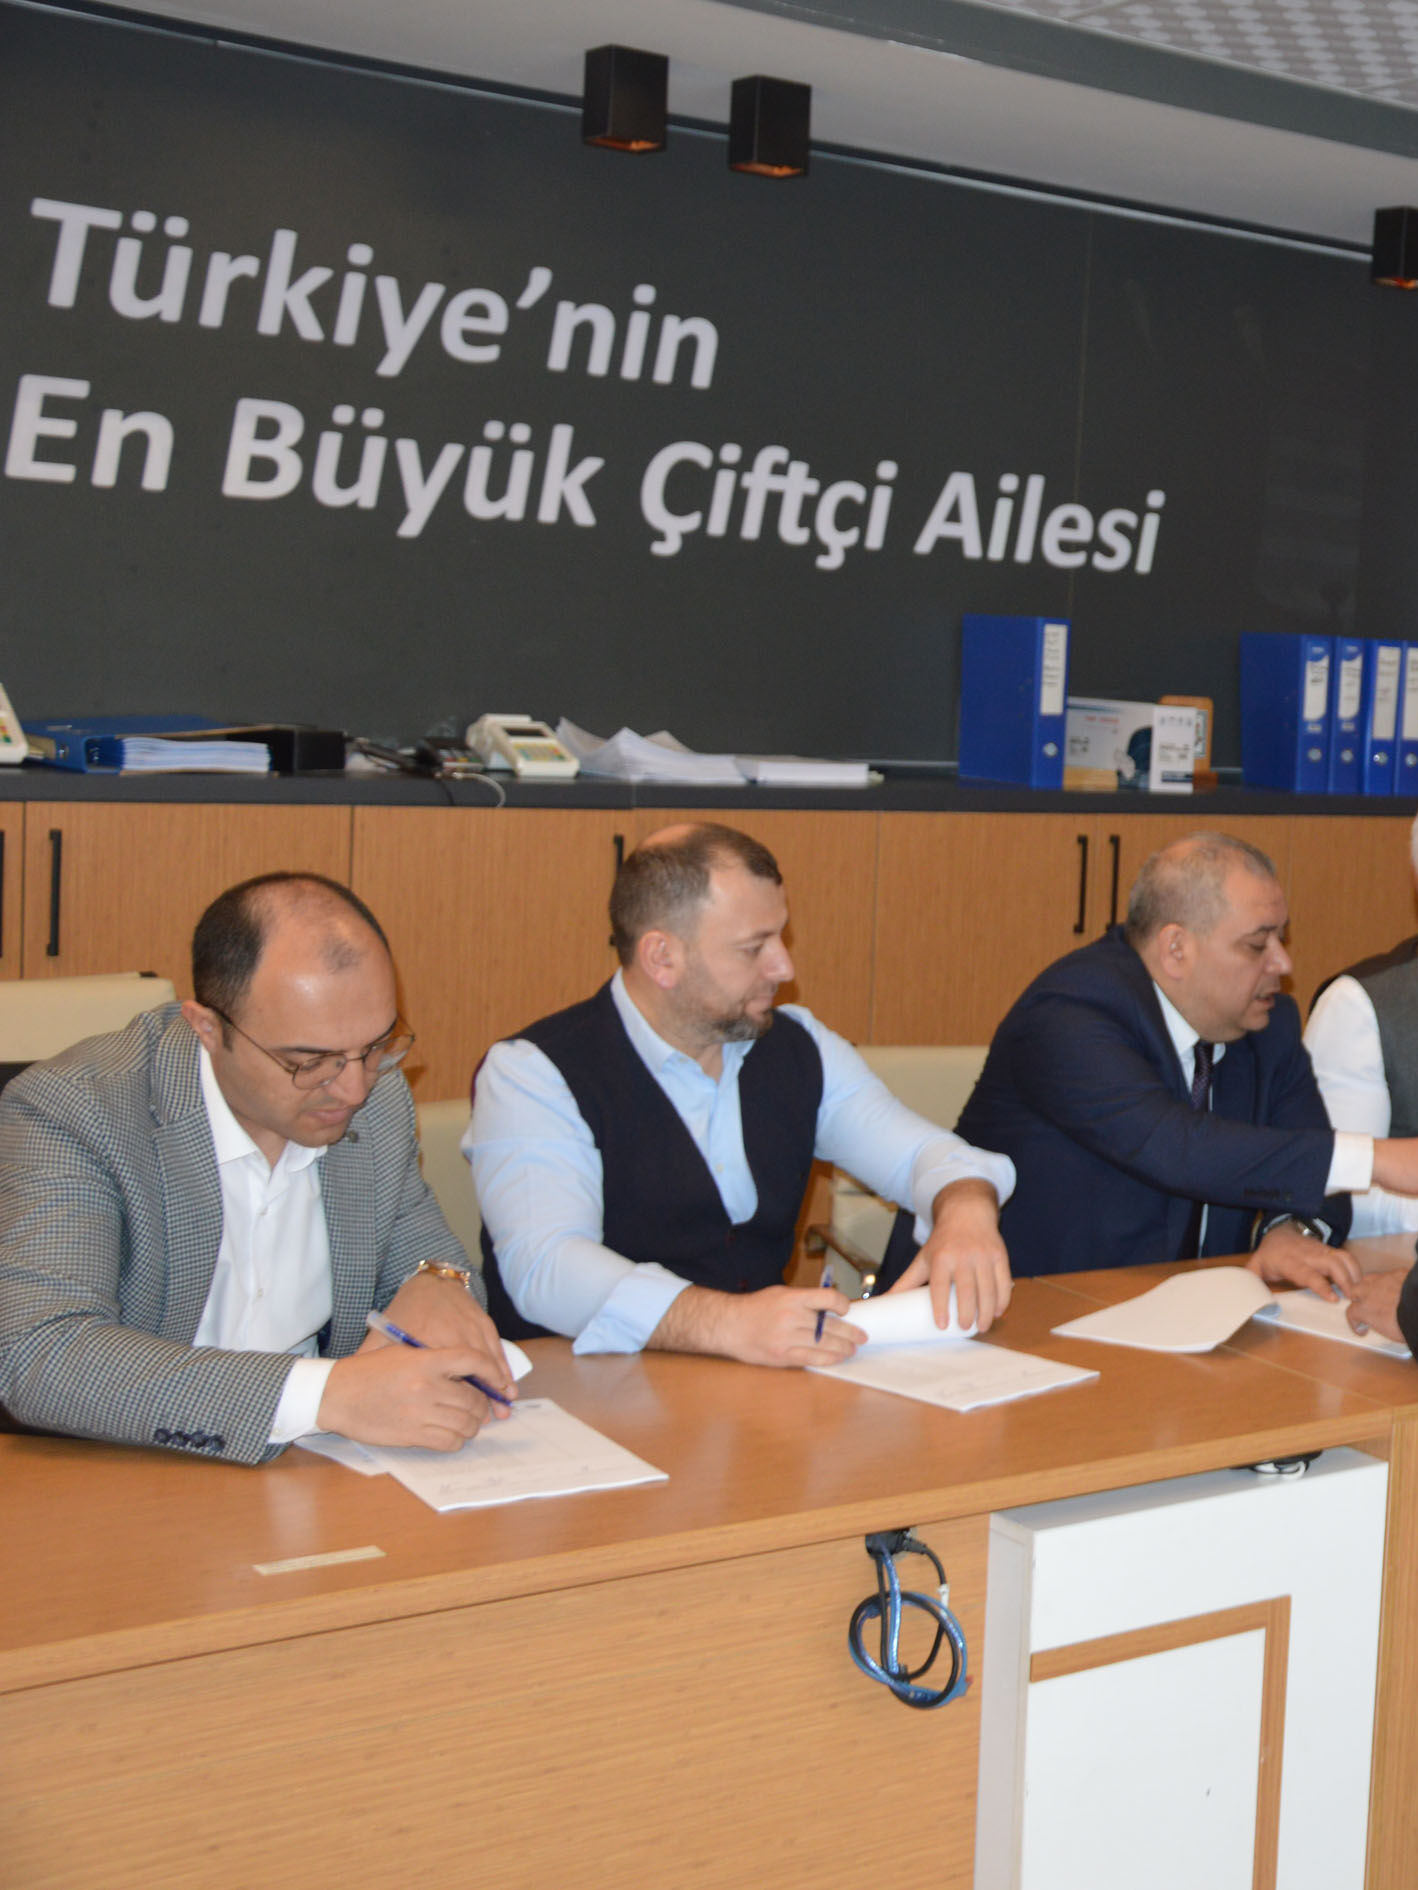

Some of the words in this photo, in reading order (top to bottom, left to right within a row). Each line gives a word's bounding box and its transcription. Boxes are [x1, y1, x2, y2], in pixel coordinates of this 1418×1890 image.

[31, 198, 718, 389] Türkiye’nin
[4, 373, 174, 492] En
[221, 397, 605, 538] Büyük
[640, 441, 898, 570] Çiftçi
[913, 471, 1165, 574] Ailesi
